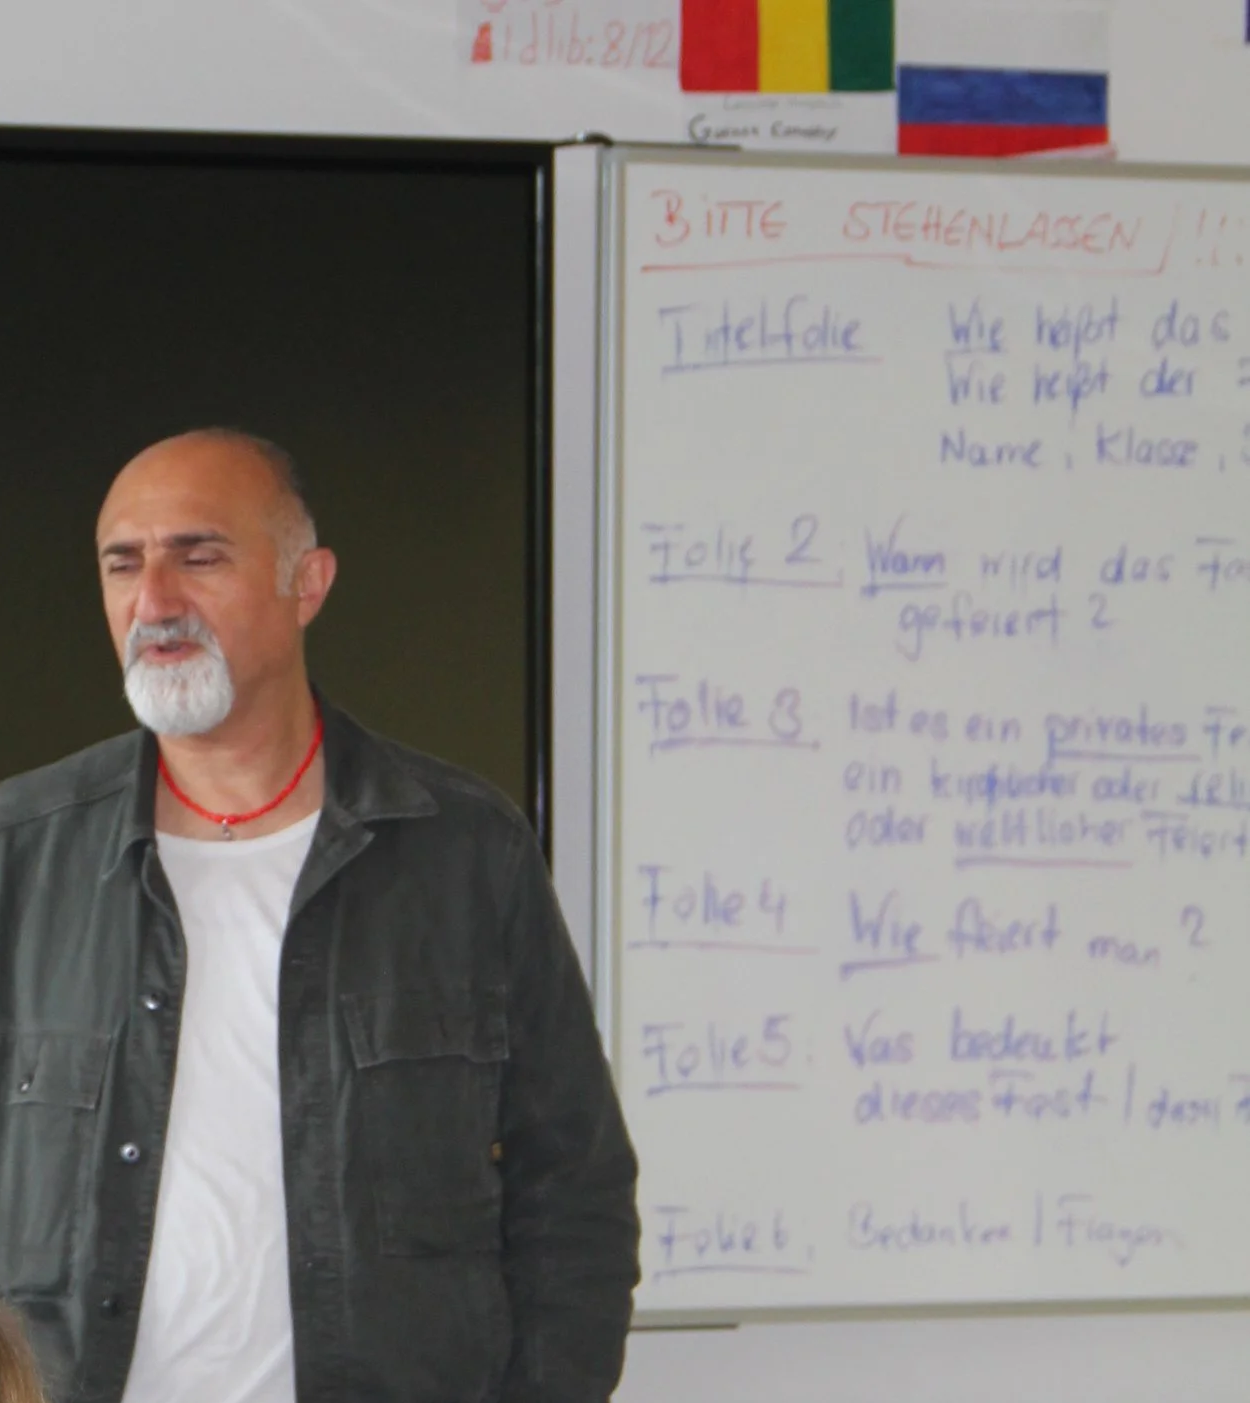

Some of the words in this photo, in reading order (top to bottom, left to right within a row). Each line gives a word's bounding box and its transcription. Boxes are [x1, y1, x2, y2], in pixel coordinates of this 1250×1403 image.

[1151, 298, 1231, 350] das
[1140, 356, 1199, 398] der
[641, 522, 756, 580] Folie
[1101, 542, 1175, 586] das
[635, 673, 748, 735] Folie
[966, 713, 1021, 743] ein
[844, 760, 902, 794] ein
[638, 865, 745, 938] Folie
[849, 888, 923, 955] Wie
[642, 1021, 749, 1081] Folie
